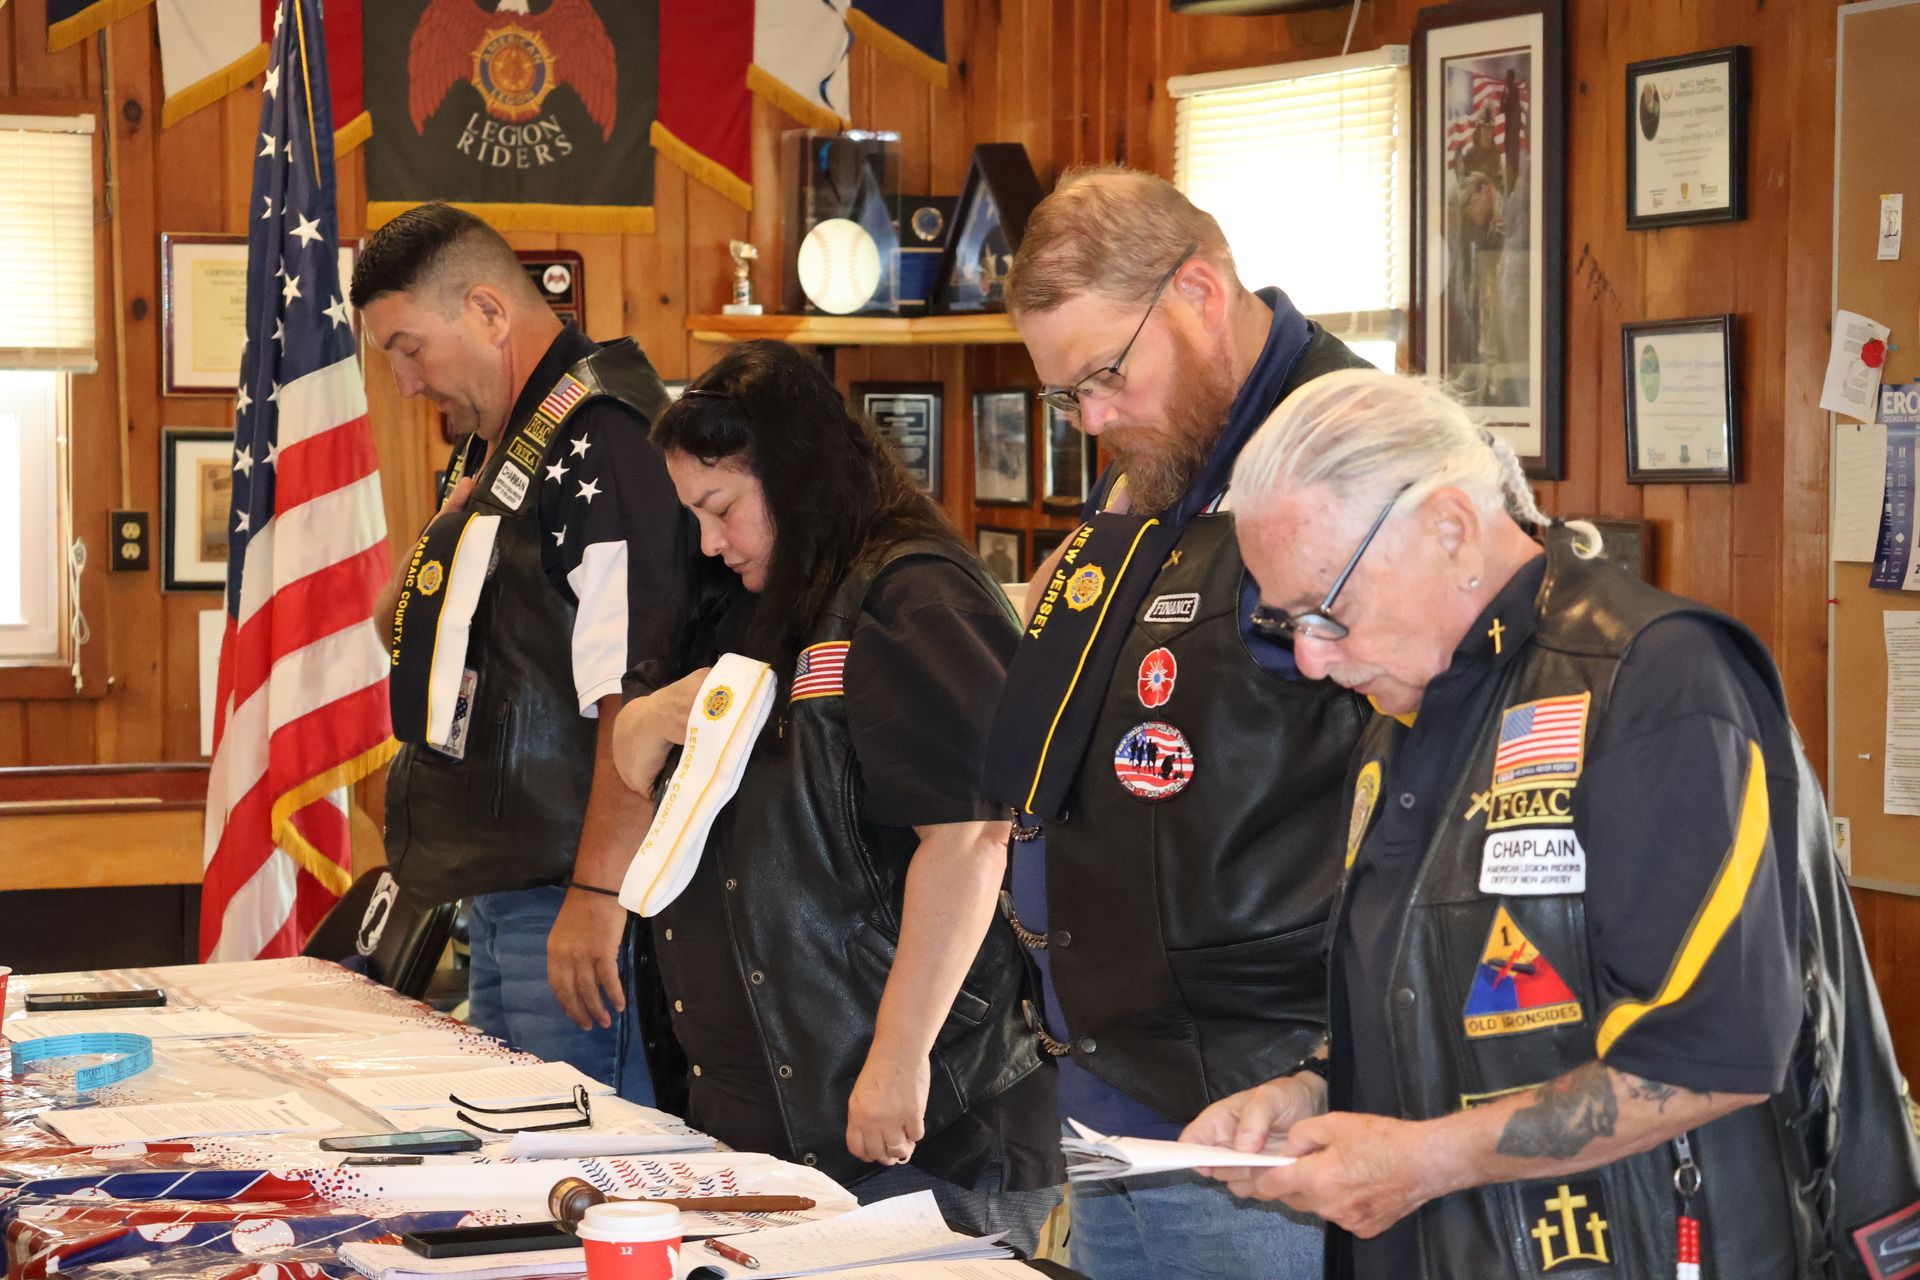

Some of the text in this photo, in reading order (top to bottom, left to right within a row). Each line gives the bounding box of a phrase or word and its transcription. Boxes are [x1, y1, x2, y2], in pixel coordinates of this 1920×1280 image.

[467, 112, 562, 147] LEGION
[456, 131, 573, 169] RIDERS
[1883, 391, 1920, 415] ERC
[1064, 526, 1094, 565] NEW
[405, 535, 430, 587] PASSAIC
[1029, 568, 1066, 640] JERSEY
[1153, 600, 1194, 616] FINANCE
[391, 649, 400, 666] NJ
[679, 727, 698, 779] BERGEN
[1497, 788, 1571, 822] FGAC
[640, 839, 654, 856] NJ
[1492, 840, 1576, 859] CHAPLAIN
[1487, 864, 1580, 873] AMERICAN LEGION RIDERS
[1520, 876, 1538, 884] NEW
[1540, 876, 1571, 884] JERSEY
[1501, 926, 1511, 946] 1
[1468, 1006, 1578, 1032] OLD IRONSIDES
[620, 1246, 633, 1255] 12
